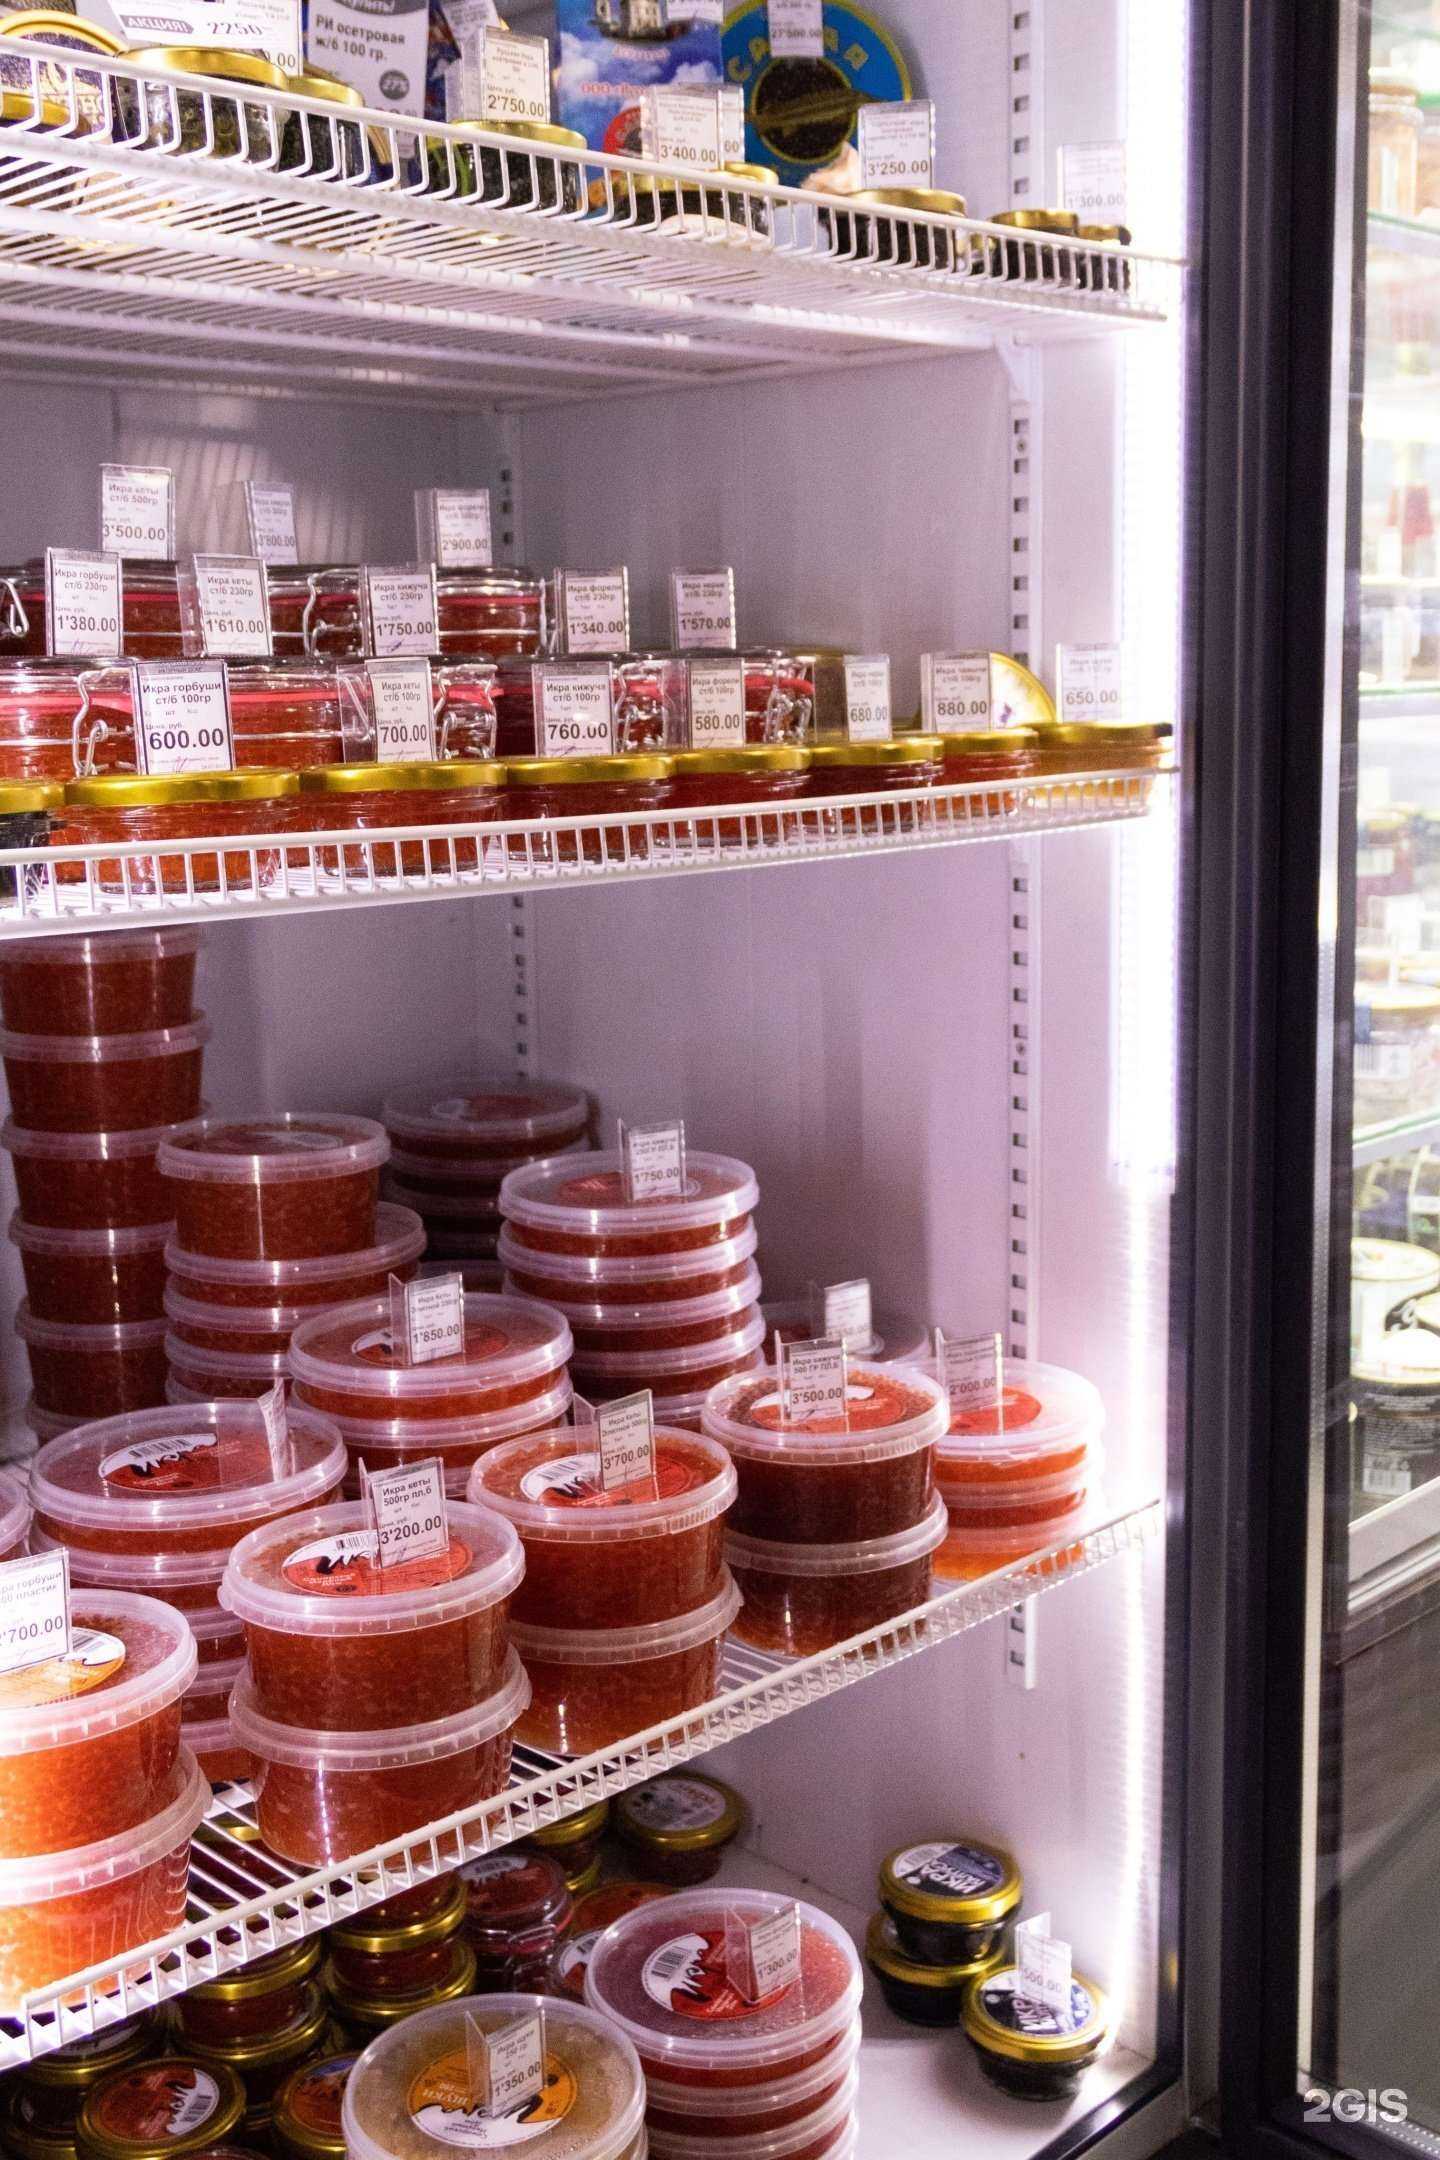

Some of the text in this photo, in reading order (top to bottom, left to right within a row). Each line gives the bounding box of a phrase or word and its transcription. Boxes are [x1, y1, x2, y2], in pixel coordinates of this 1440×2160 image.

[126, 15, 189, 33] АКЦИЯ!
[316, 14, 405, 44] РИ осетровая
[343, 41, 366, 57] 100
[488, 94, 544, 117] 2'750.00
[660, 144, 717, 162] 3'400.00
[868, 160, 929, 177] 3'250.00
[108, 483, 132, 496] Икра
[103, 524, 166, 541] 3'500.00
[442, 538, 488, 551] 2'900.00
[55, 568, 78, 578] Икра
[207, 575, 230, 586] Икра
[64, 581, 108, 592] ст/б 230гр
[230, 586, 254, 597] 230гр
[374, 583, 395, 592] Икра
[400, 592, 424, 601] 230гр
[57, 615, 117, 632] 1'380.00
[206, 619, 265, 633] 1'610.00
[376, 621, 433, 636] 1'750.00
[569, 620, 625, 635] 1'340.00
[681, 616, 731, 630] 1'570.00
[142, 681, 221, 694] Икра горбуши
[381, 681, 421, 691] Икра кеты
[546, 683, 606, 693] Икра кижуча
[155, 694, 211, 705] ст/б 100гр
[383, 691, 421, 702] ст/б 100гр
[553, 692, 601, 702] ст/б 100гр
[1065, 689, 1119, 706] 650.00
[850, 706, 888, 722] 680.00
[937, 700, 987, 716] 880.00
[695, 714, 740, 730] 580.00
[149, 727, 224, 750] 600.00
[380, 724, 427, 743] 700.00
[548, 722, 608, 740] 760.00
[634, 1166, 680, 1184] 1'750.00
[413, 1323, 460, 1344] 1'850.00
[792, 1386, 842, 1405] 3'500.00
[603, 1444, 649, 1471] 3'700.00
[383, 1478, 431, 1497] Икра кеты
[383, 1486, 432, 1507] 500гр пл.б
[381, 1515, 442, 1545] 3'200.00
[0, 1615, 63, 1647] '700.00
[494, 2061, 541, 2096] 1'350.00
